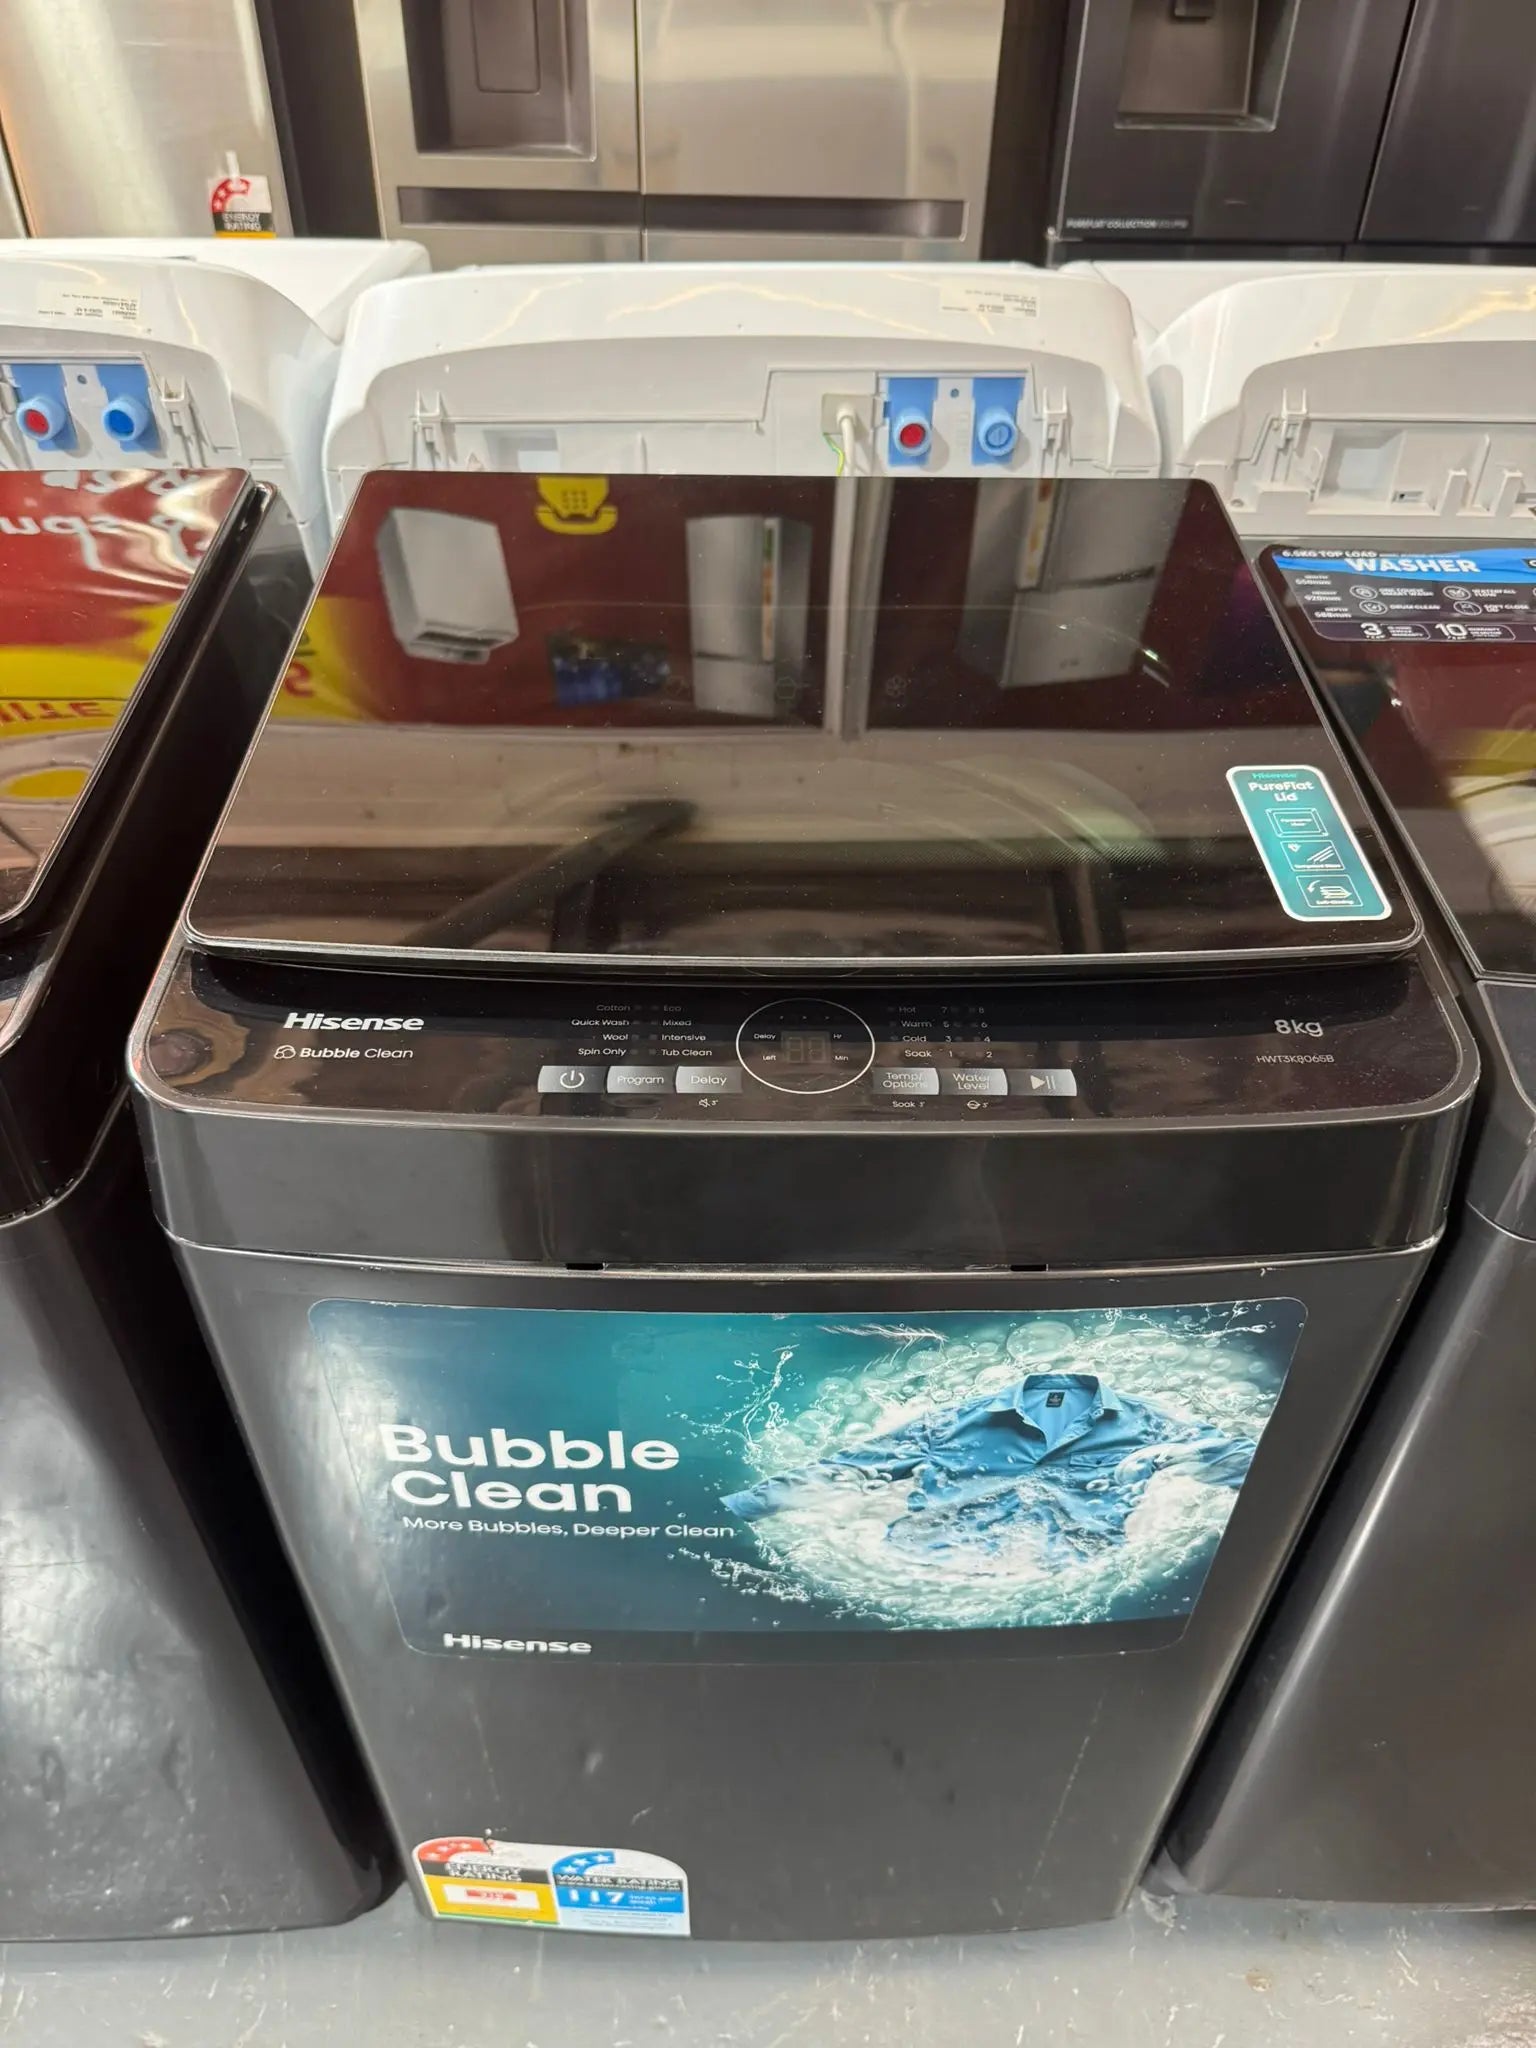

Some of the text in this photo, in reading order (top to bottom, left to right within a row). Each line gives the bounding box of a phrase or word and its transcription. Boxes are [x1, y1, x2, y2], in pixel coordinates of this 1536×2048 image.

[1343, 558, 1482, 573] WASHER
[1360, 622, 1382, 635] 3
[1435, 623, 1468, 636] 10
[1248, 781, 1315, 792] PureFlat
[1274, 793, 1298, 802] Lid
[596, 1004, 630, 1012] Cotton
[664, 1004, 682, 1012] Eco
[283, 1012, 425, 1031] Hisense
[662, 1018, 692, 1026] Mixed
[901, 1020, 932, 1028] Warm
[1274, 1019, 1324, 1037] 8kg
[602, 1033, 629, 1041] Wool
[945, 1035, 951, 1043] 3
[984, 1035, 991, 1043] 4
[300, 1047, 414, 1059] Bubble Clean
[578, 1047, 626, 1056] Spin Only
[617, 1075, 665, 1086] Program
[690, 1075, 728, 1086] Delay
[952, 1073, 990, 1082] Water
[882, 1080, 928, 1089] Options
[957, 1081, 989, 1090] Level
[892, 1100, 916, 1108] Soak
[379, 1422, 680, 1470] Bubble
[390, 1469, 632, 1513] Clean
[402, 1516, 735, 1540] More Bubbles, Deeper Clean
[443, 1632, 592, 1654] Hisense
[450, 1871, 523, 1882] RATING
[558, 1873, 613, 1883] WATER
[617, 1877, 680, 1887] RATING
[569, 1888, 625, 1905] 117
